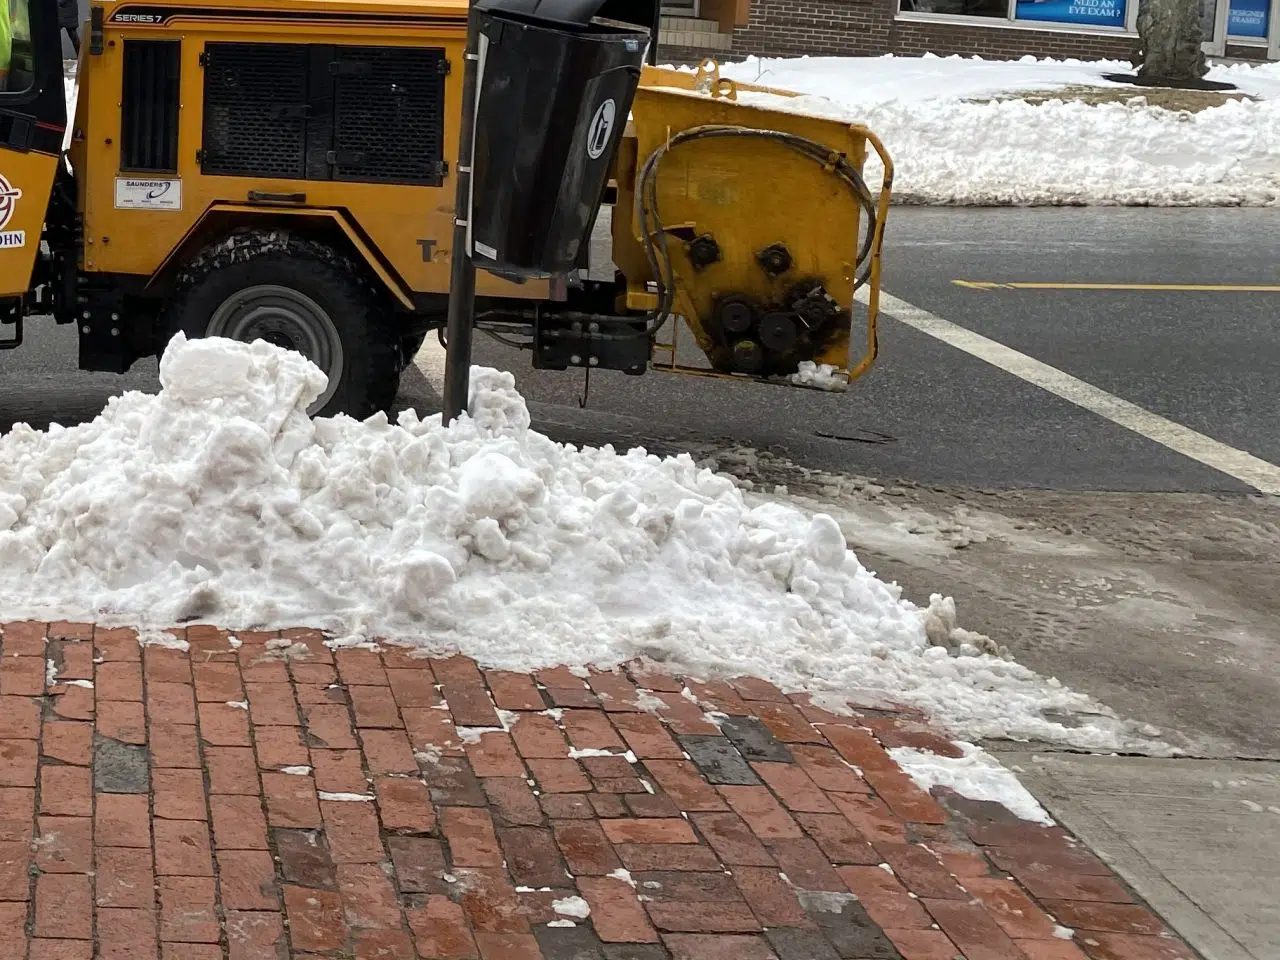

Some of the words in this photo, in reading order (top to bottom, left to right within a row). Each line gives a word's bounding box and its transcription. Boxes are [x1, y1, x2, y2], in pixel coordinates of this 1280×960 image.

[1100, 0, 1116, 9] AN
[1068, 5, 1087, 16] EYE
[115, 14, 154, 23] SERIES
[155, 15, 162, 23] 7
[126, 180, 163, 188] SAUNDERS
